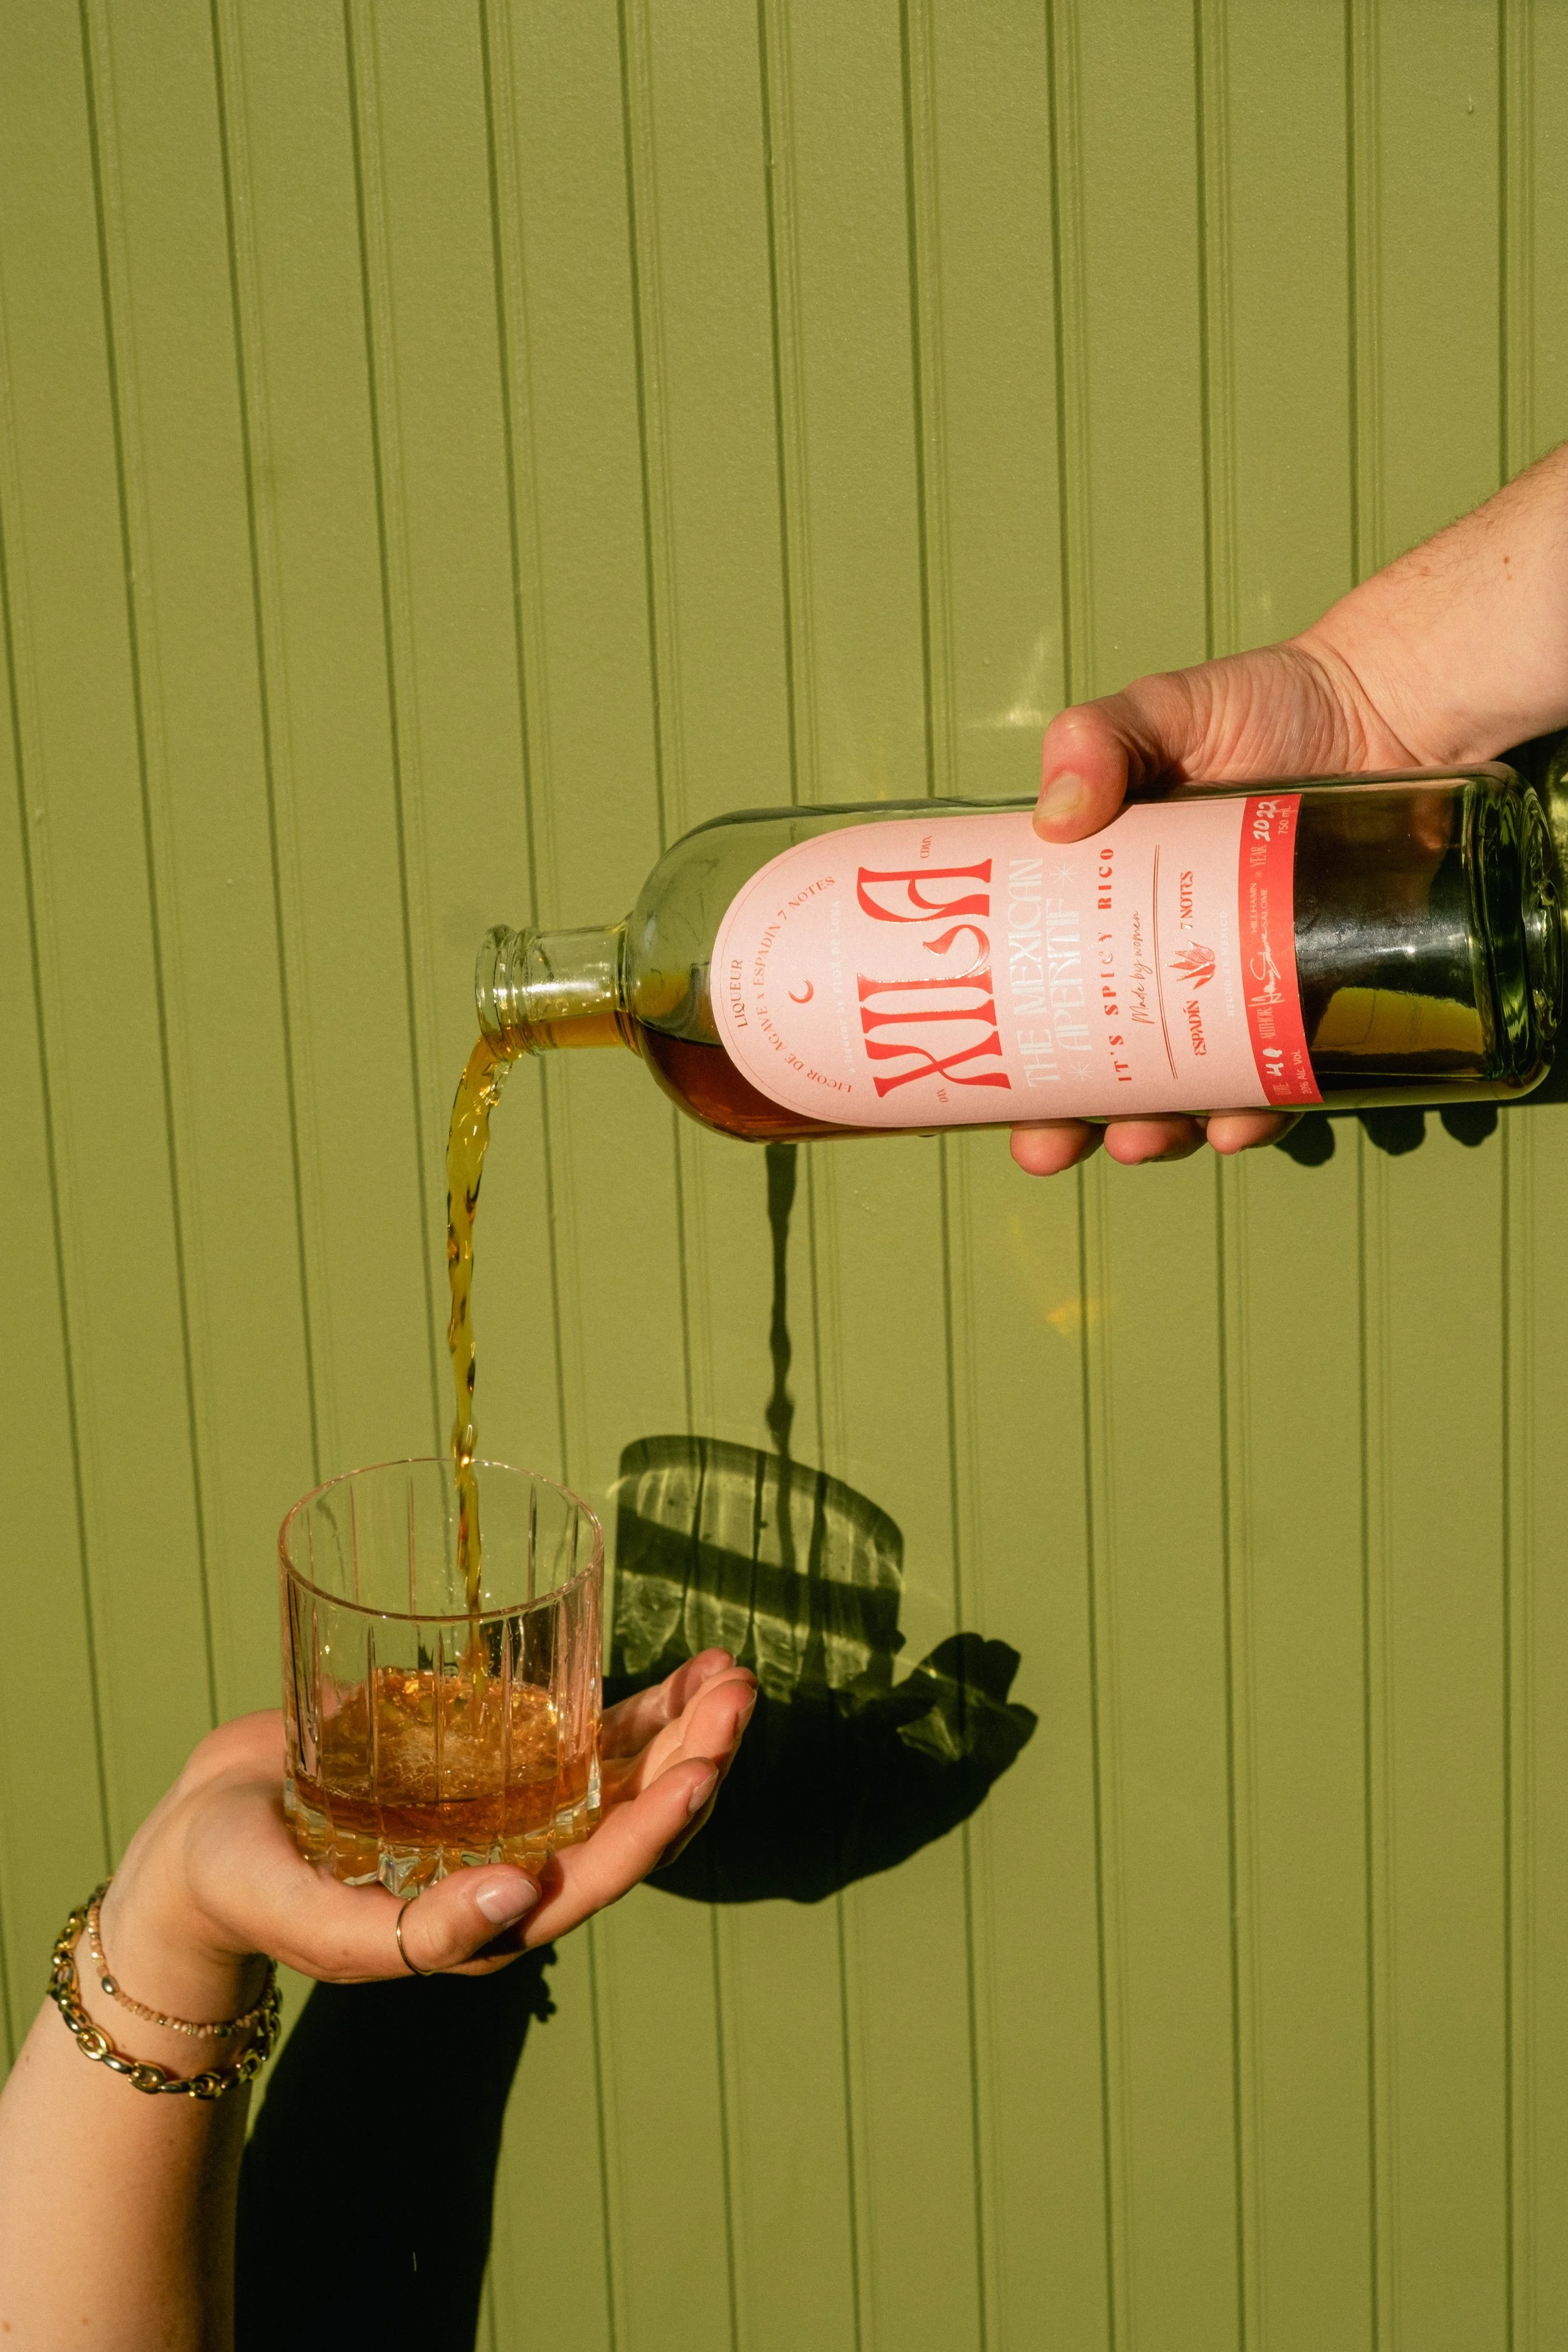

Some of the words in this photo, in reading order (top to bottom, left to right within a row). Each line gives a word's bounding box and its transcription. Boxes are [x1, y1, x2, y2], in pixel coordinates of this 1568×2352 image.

[1278, 820, 1289, 835] 750
[1281, 805, 1291, 817] mL
[789, 876, 835, 909] NOTES
[1098, 848, 1115, 909] RICO
[1179, 871, 1194, 918] NOTES
[777, 908, 788, 919] 7
[830, 901, 841, 932] LUNA
[1180, 922, 1194, 930] 7
[1260, 887, 1268, 928] SALOME
[753, 921, 781, 986] ESPADÍN
[831, 939, 840, 955] DE
[1007, 858, 1047, 1015] MEXICAN
[1131, 911, 1143, 956] women
[832, 961, 844, 994] FLOR
[857, 858, 1011, 1098] XILA
[1046, 897, 1093, 1051] APERITIF
[1098, 931, 1119, 1015] SPICY
[1129, 958, 1153, 980] by
[1223, 961, 1231, 973] EN
[730, 959, 748, 1028] LIQUEUR
[835, 1000, 847, 1014] by
[1129, 983, 1155, 1024] Made
[1224, 980, 1236, 1017] HECHO
[756, 1006, 785, 1051] AGAVE
[839, 1020, 853, 1063] liqueur
[1184, 1000, 1207, 1056] ESPADÍN
[785, 1053, 805, 1071] DE
[1017, 1029, 1061, 1088] THE
[1108, 1034, 1132, 1082] IT'S
[807, 1069, 852, 1093] LICOR
[1300, 1082, 1312, 1094] 20%
